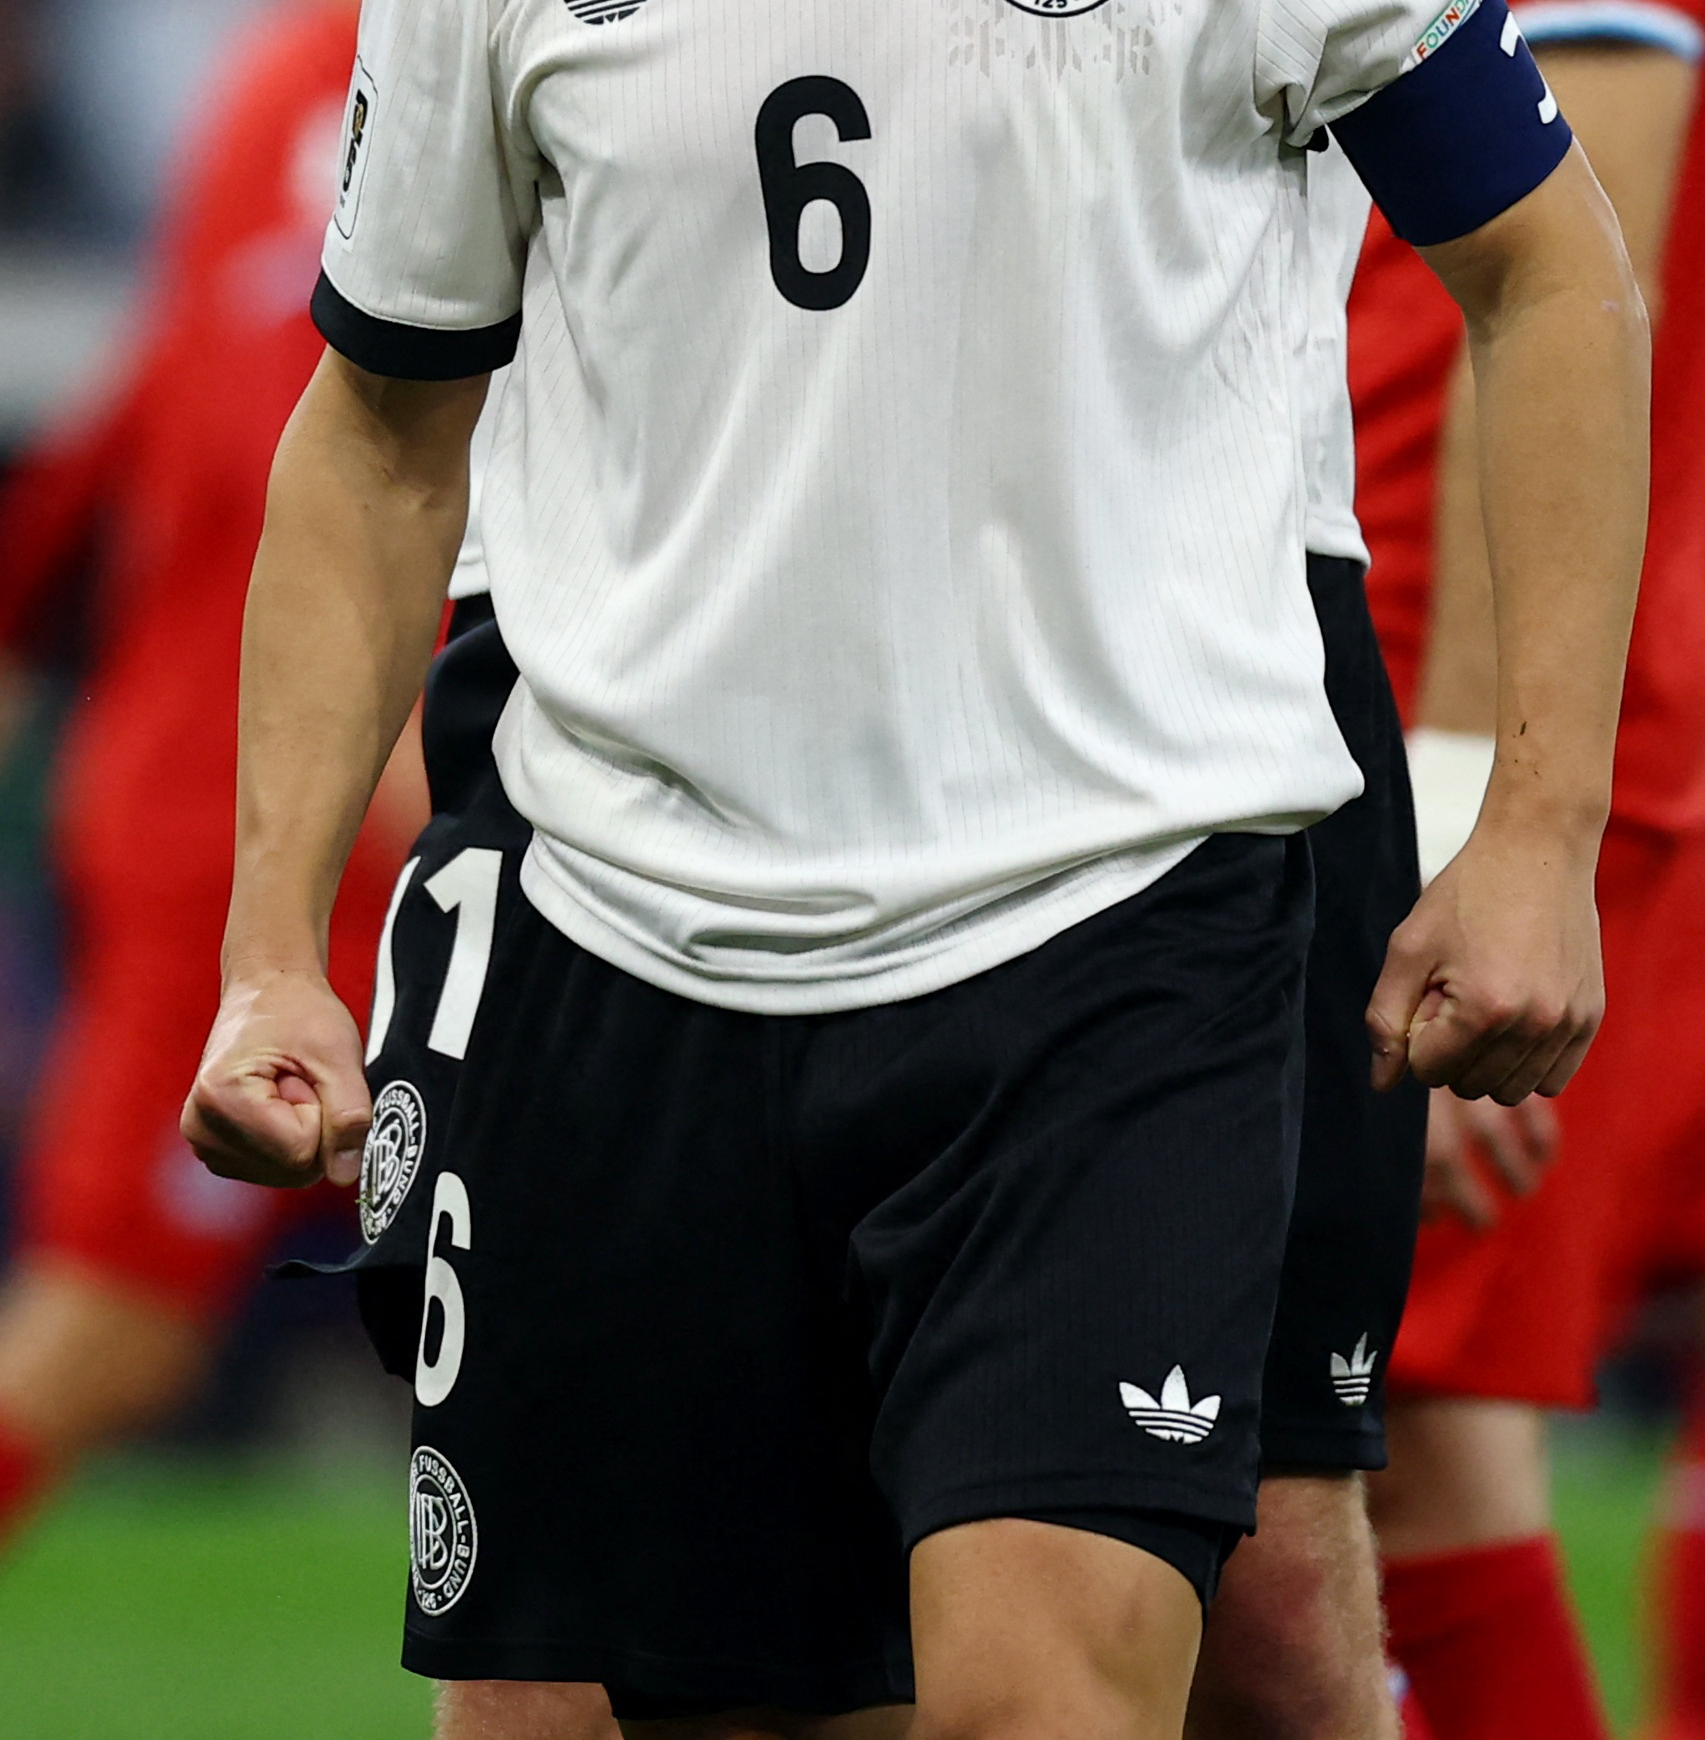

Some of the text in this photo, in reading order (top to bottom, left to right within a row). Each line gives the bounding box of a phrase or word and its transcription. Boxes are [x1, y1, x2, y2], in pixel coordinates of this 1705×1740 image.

[755, 75, 872, 311] 6
[415, 1171, 471, 1408] 6
[418, 1454, 471, 1599] FUSSBALL-BUND
